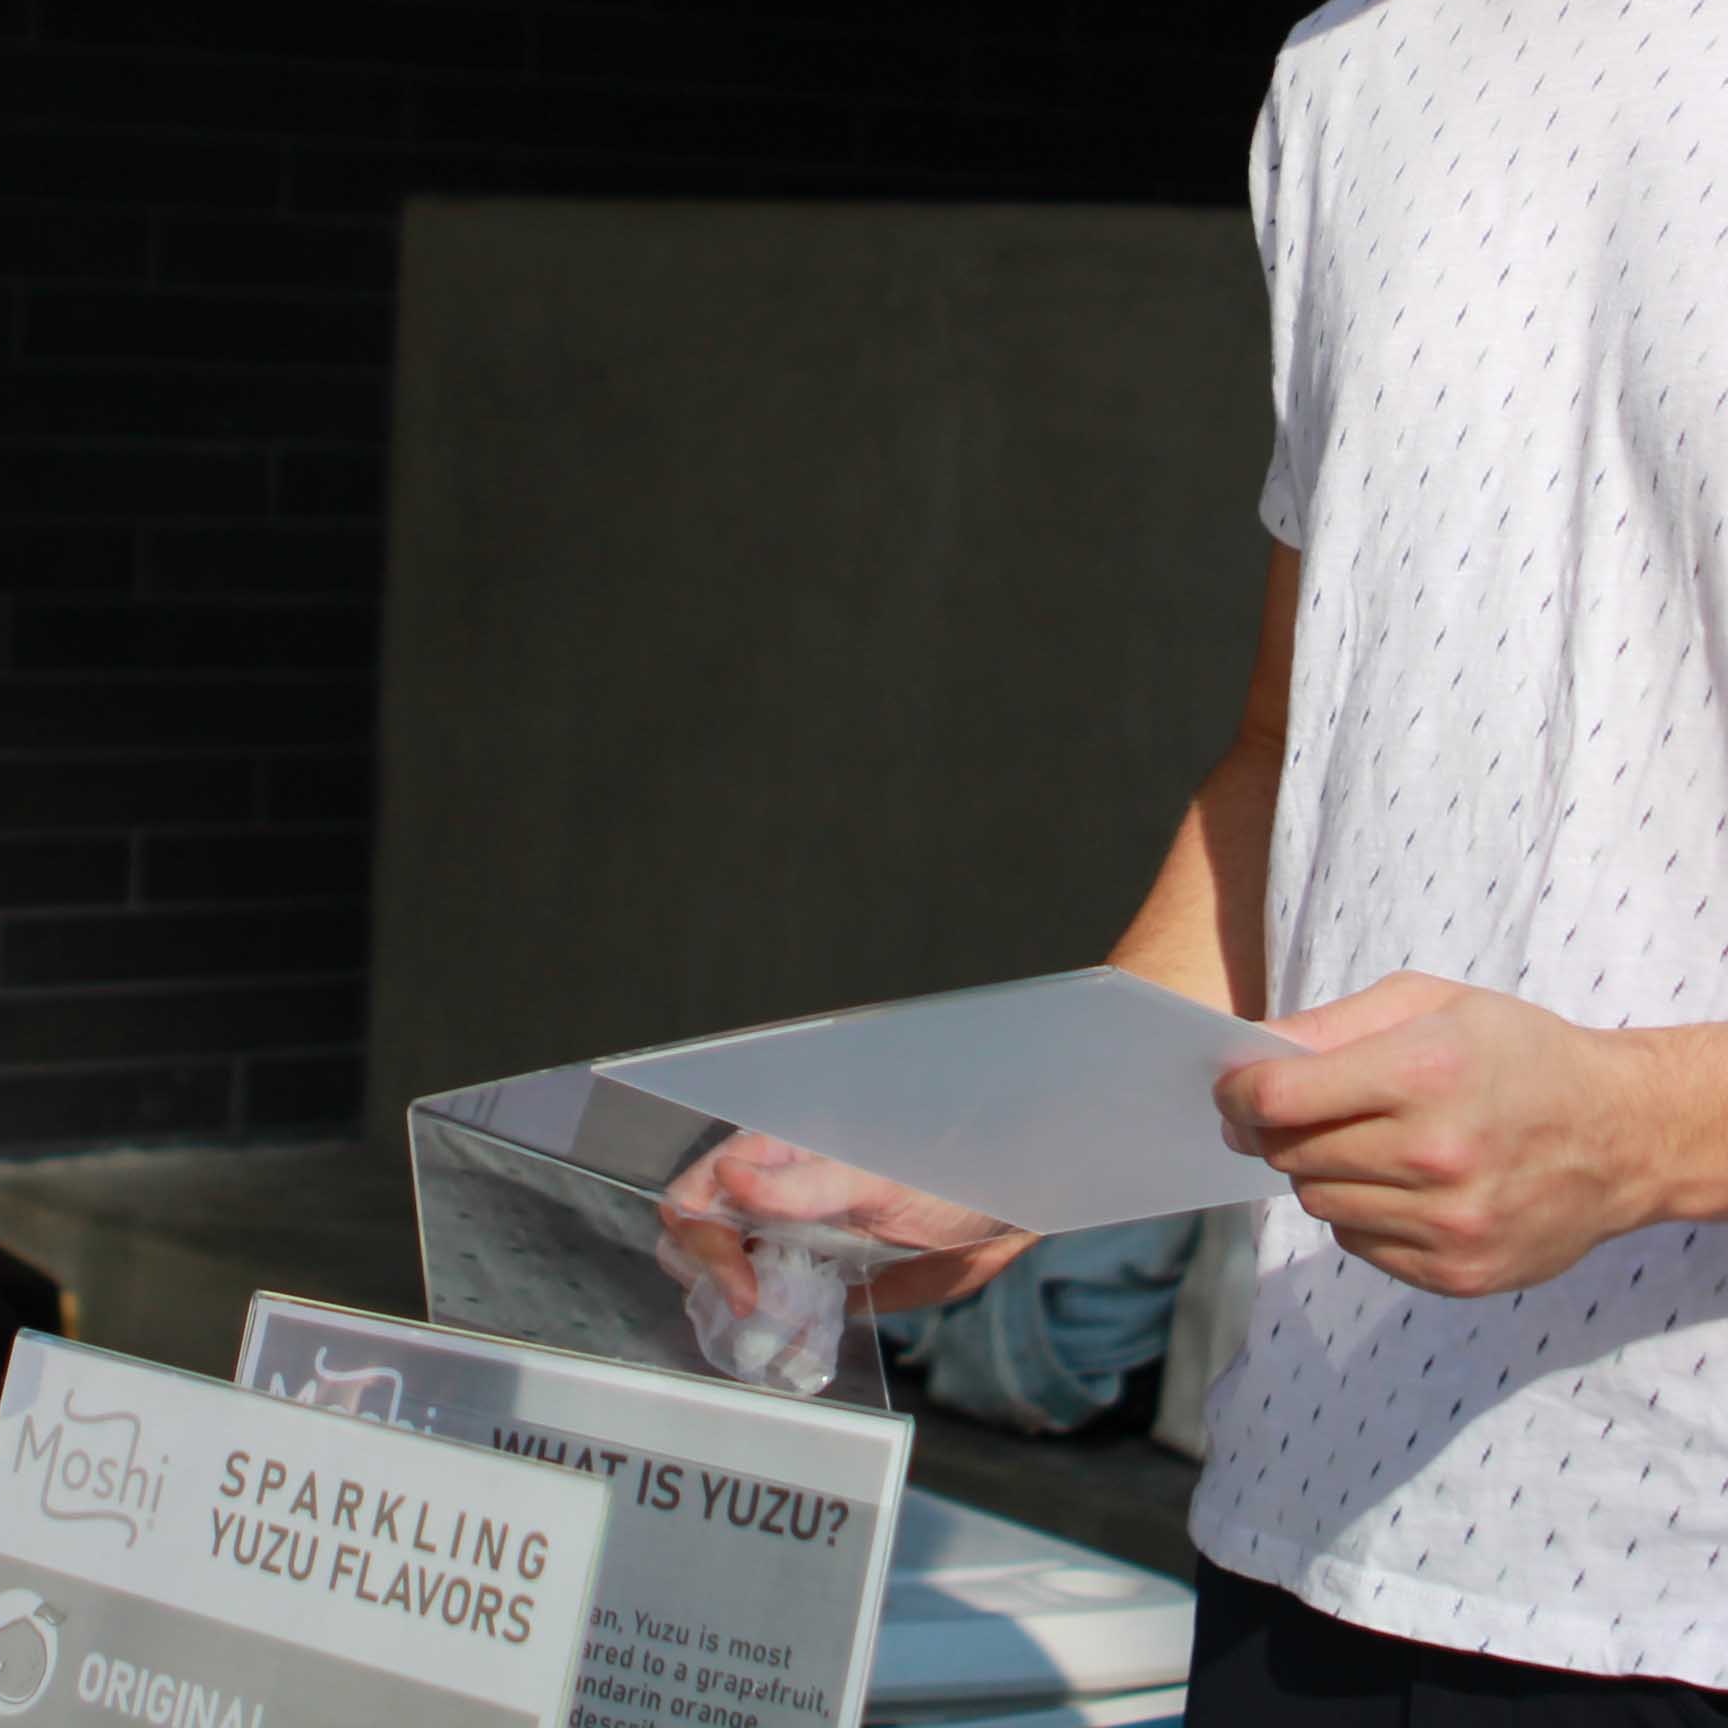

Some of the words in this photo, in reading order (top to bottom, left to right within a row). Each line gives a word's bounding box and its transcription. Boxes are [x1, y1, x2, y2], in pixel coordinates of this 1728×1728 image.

[13, 1388, 170, 1550] Moshi
[636, 1460, 684, 1511] IS
[701, 1470, 850, 1547] YUZU?
[219, 1449, 549, 1581] SPARKLING
[211, 1505, 320, 1582] YUZU
[329, 1543, 536, 1645] FLAVORS
[583, 1640, 635, 1670] ared
[643, 1649, 665, 1676] to
[674, 1659, 688, 1682] a
[696, 1666, 832, 1719] grapefruit,
[589, 1607, 623, 1634] an,
[634, 1609, 690, 1648] Yuzu
[699, 1623, 720, 1653] is
[729, 1640, 793, 1670] most
[575, 1674, 663, 1713] ndarin
[671, 1696, 759, 1728] orange
